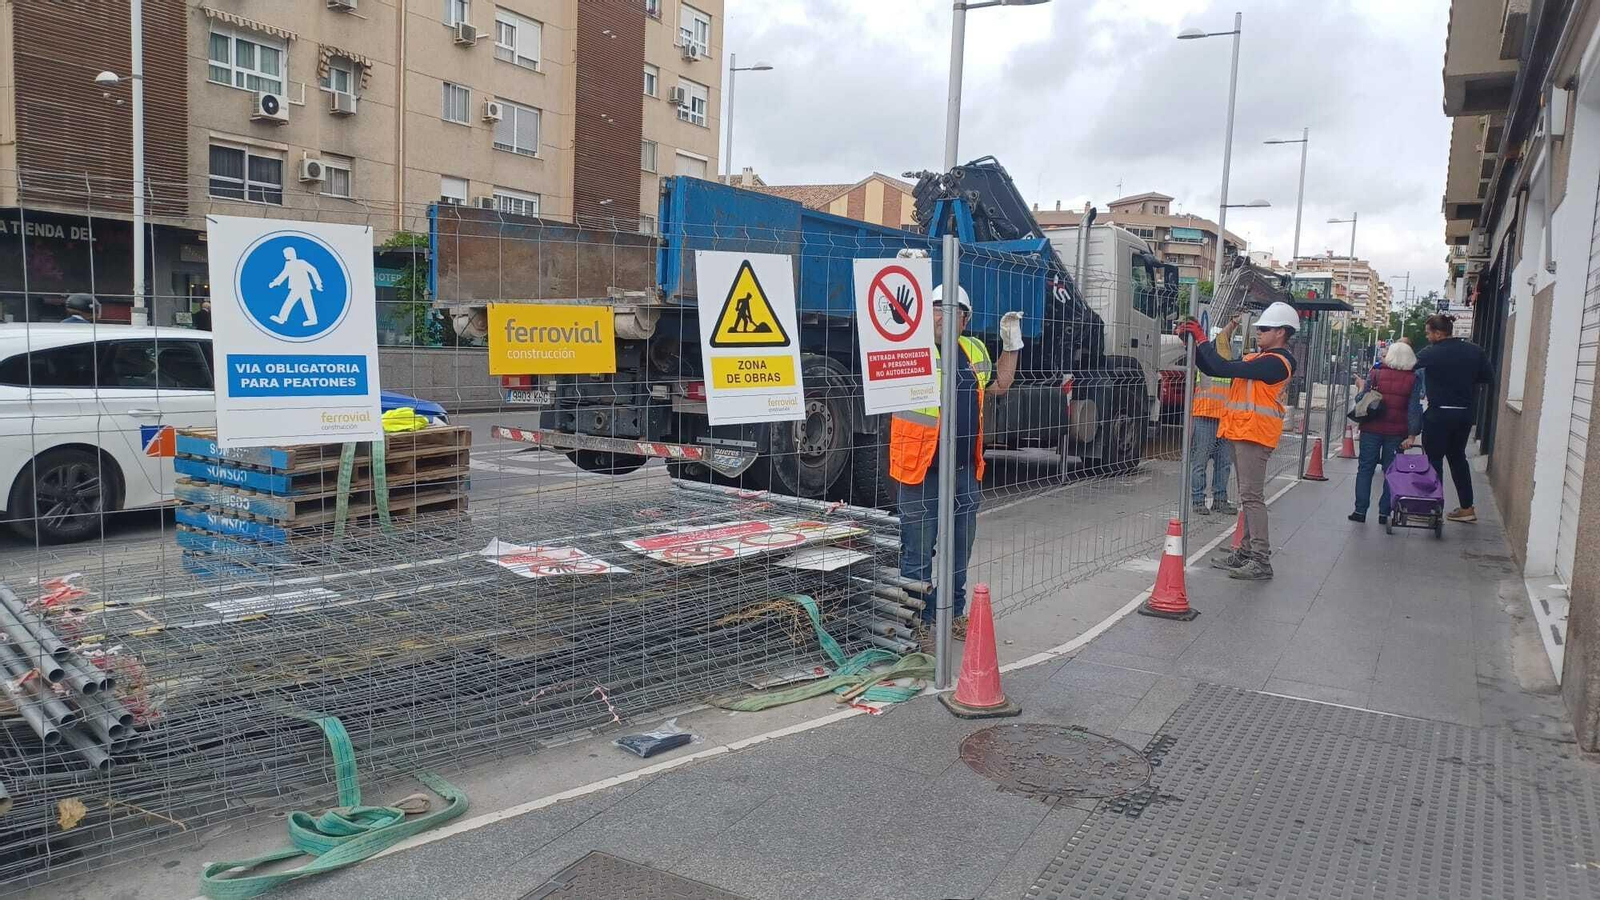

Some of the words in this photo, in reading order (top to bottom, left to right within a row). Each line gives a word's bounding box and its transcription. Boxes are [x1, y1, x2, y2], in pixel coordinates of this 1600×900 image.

[10, 220, 65, 238] TENDA
[70, 226, 97, 241] DEL
[505, 319, 602, 343] ferrovial
[507, 348, 576, 359] construcción
[869, 354, 896, 362] ENTRADA
[896, 351, 929, 359] PROHIBIDA
[235, 363, 261, 374] VIA
[265, 363, 360, 374] OBLIGATORIA
[737, 360, 767, 370] ZONA
[888, 360, 918, 368] PERSONAS
[885, 367, 925, 376] AUTORIZADAS
[241, 377, 279, 388] PARA
[283, 377, 357, 388] PEATONES
[726, 374, 741, 383] DE
[744, 373, 781, 383] OBRAS
[512, 390, 531, 402] 9903
[321, 411, 371, 423] ferrovial
